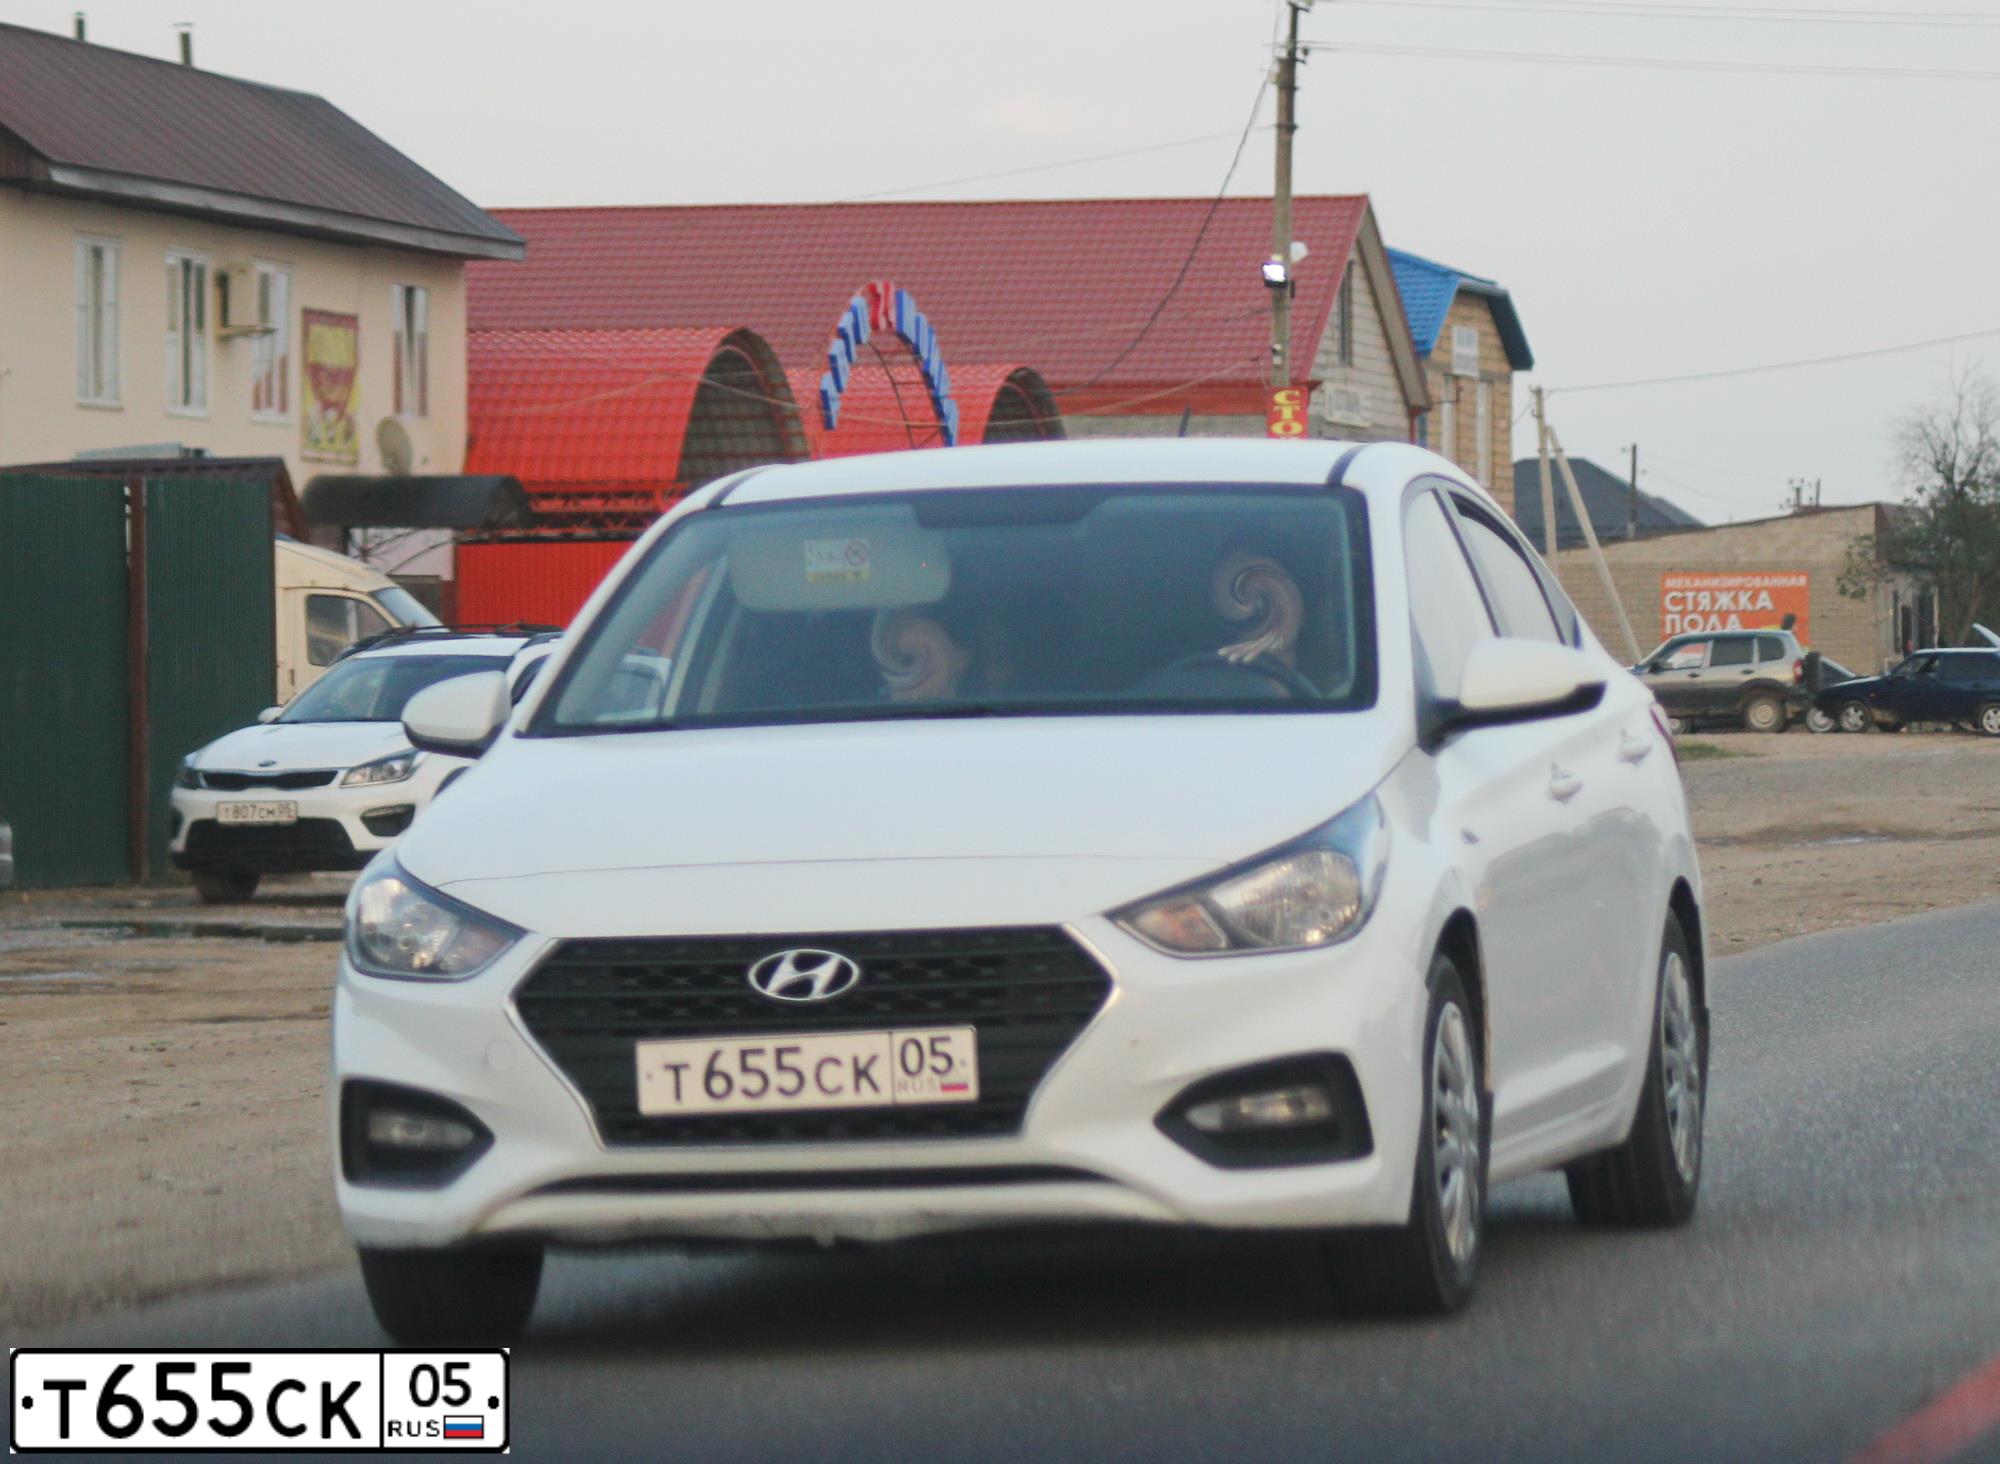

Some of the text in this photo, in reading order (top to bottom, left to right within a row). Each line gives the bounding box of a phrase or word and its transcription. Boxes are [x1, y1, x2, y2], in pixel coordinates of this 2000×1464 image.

[1665, 576, 1807, 588] МЕХАНИЗИРОВАННАЯ
[1664, 591, 1774, 612] СТЯЖКА
[1664, 613, 1743, 634] ПОЛА
[899, 1037, 954, 1077] 05
